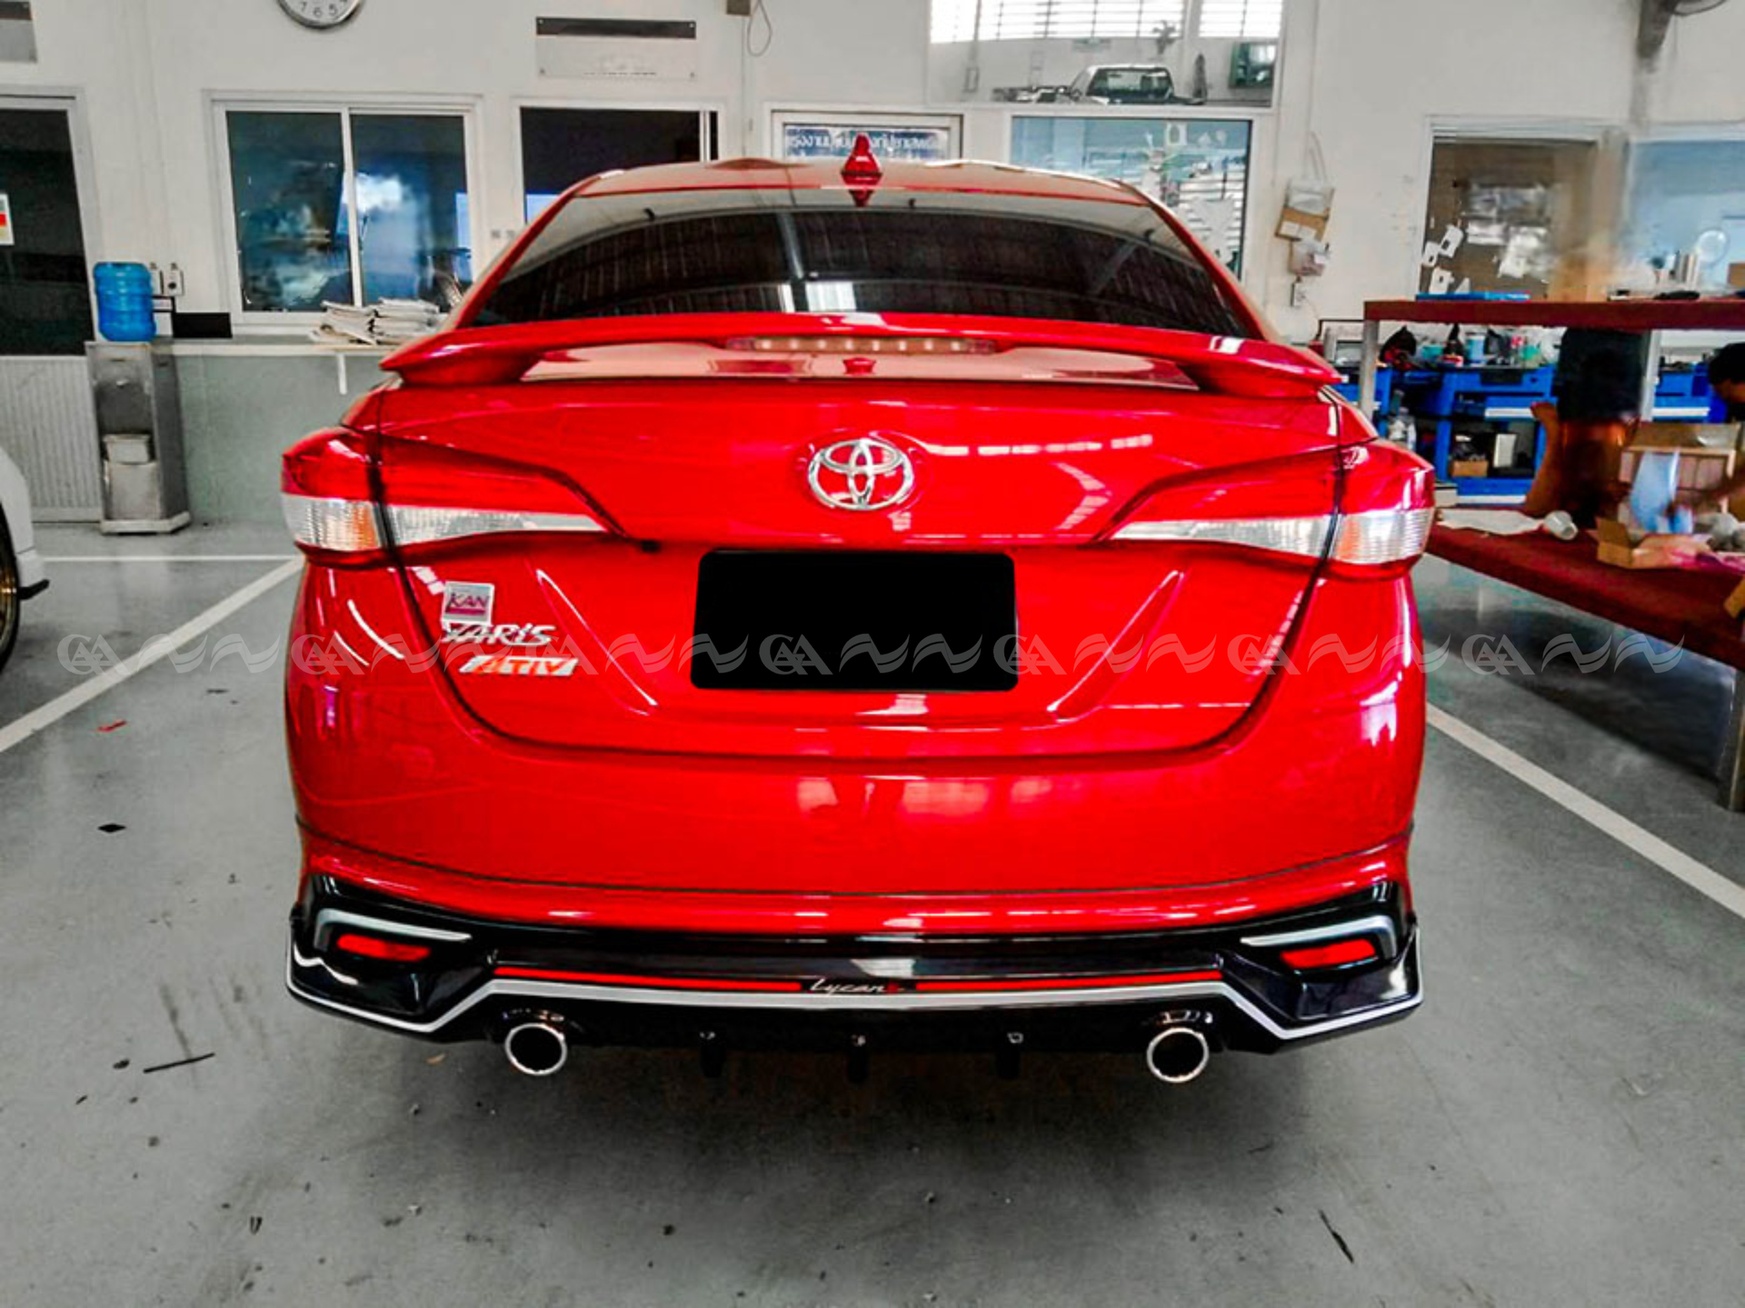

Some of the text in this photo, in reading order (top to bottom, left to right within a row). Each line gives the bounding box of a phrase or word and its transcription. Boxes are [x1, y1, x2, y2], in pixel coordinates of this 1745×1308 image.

[313, 7, 322, 18] 6
[328, 4, 338, 16] 5
[445, 592, 491, 613] KAN
[810, 978, 885, 997] Lycan
